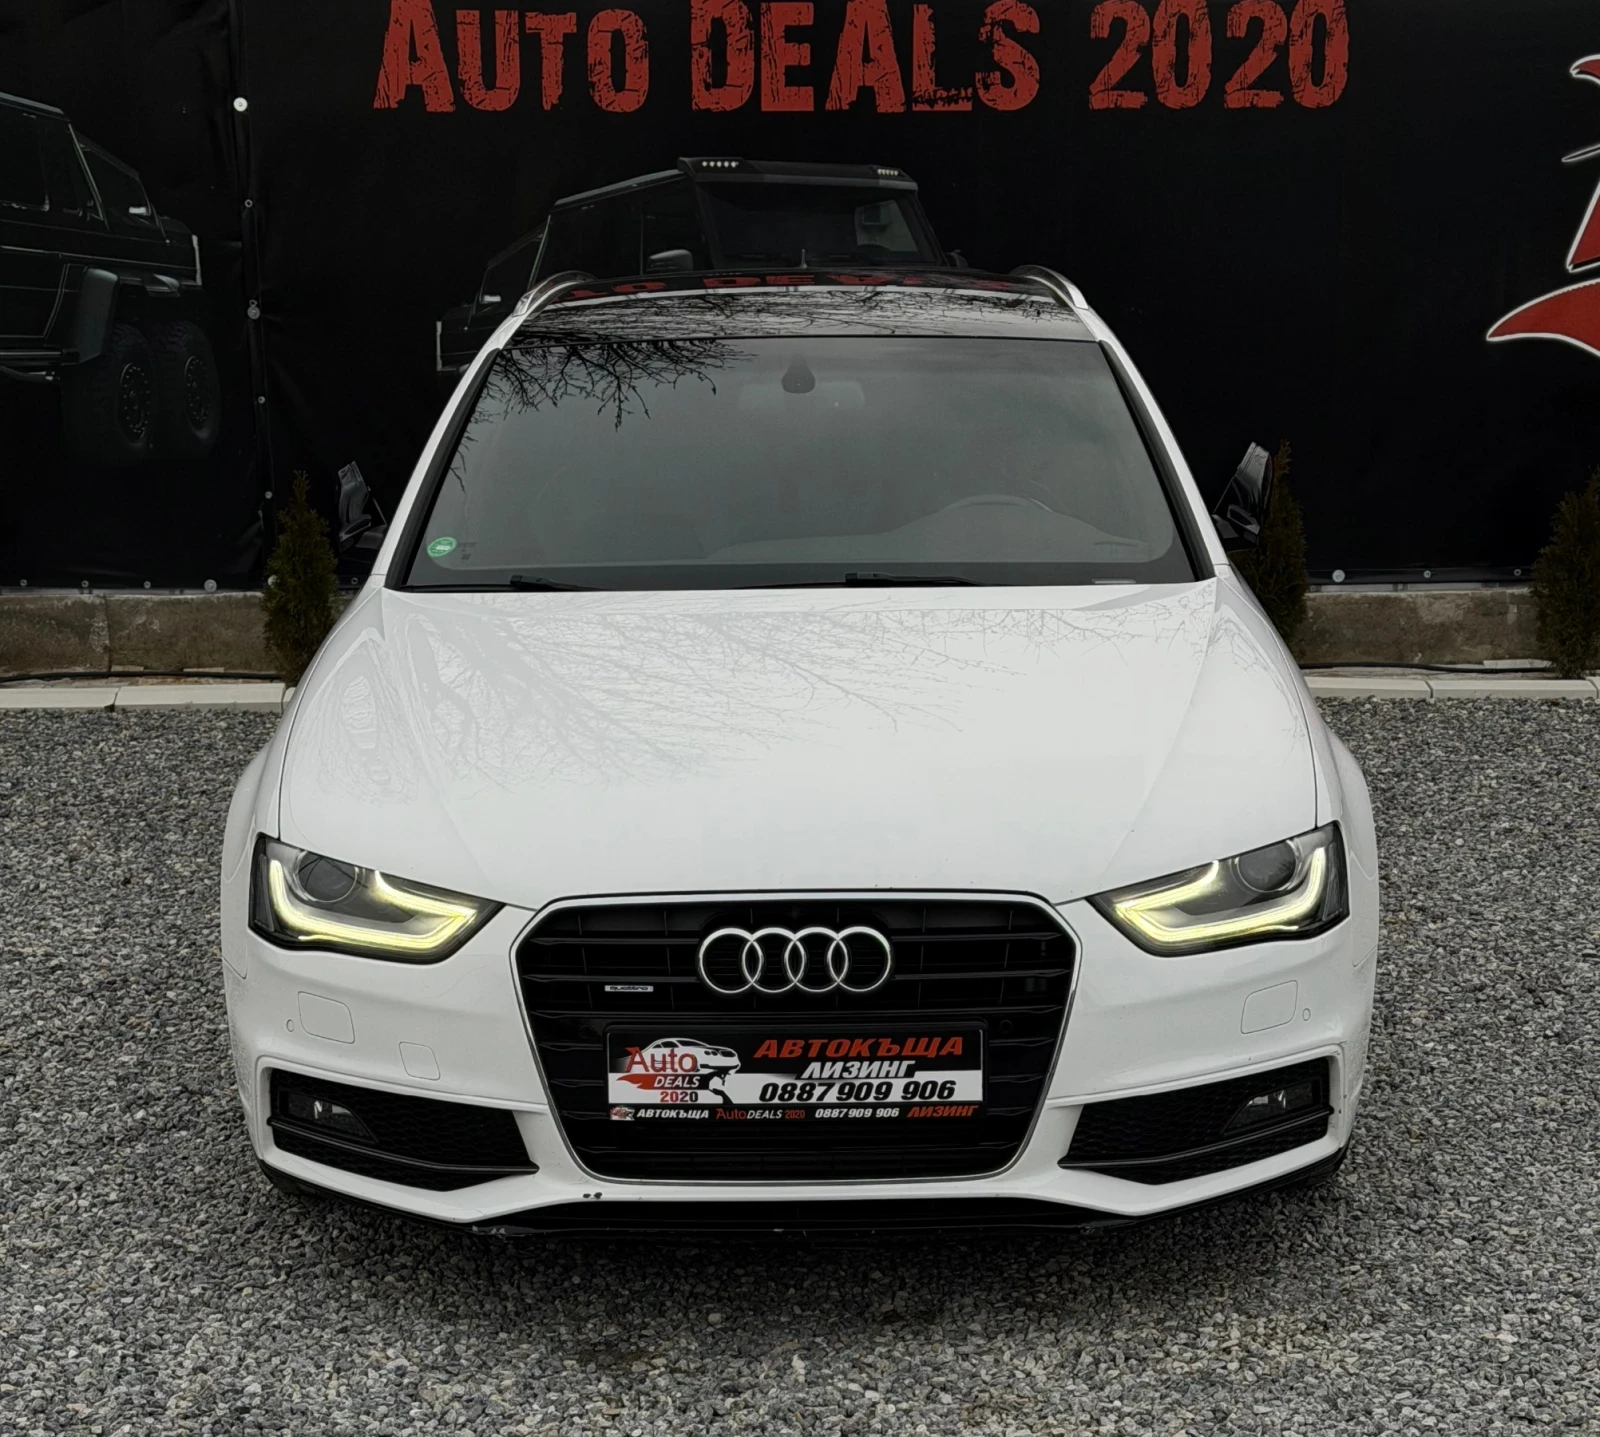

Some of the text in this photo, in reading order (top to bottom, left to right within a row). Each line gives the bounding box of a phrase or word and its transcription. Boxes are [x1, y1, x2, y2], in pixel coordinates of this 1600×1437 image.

[1089, 0, 1350, 109] 2020
[753, 1037, 963, 1058] АВТОКЪЩА
[624, 1047, 698, 1073] Auto
[800, 1060, 916, 1079] ЛИЗИНГ
[653, 1076, 701, 1088] DEALS
[901, 1080, 957, 1100] 906
[660, 1091, 699, 1103] 2020
[636, 1108, 709, 1119] АВТОКЪЩА
[784, 1109, 806, 1119] 2020
[875, 1107, 900, 1117] 906
[907, 1105, 979, 1118] ЛИЗИНГ
